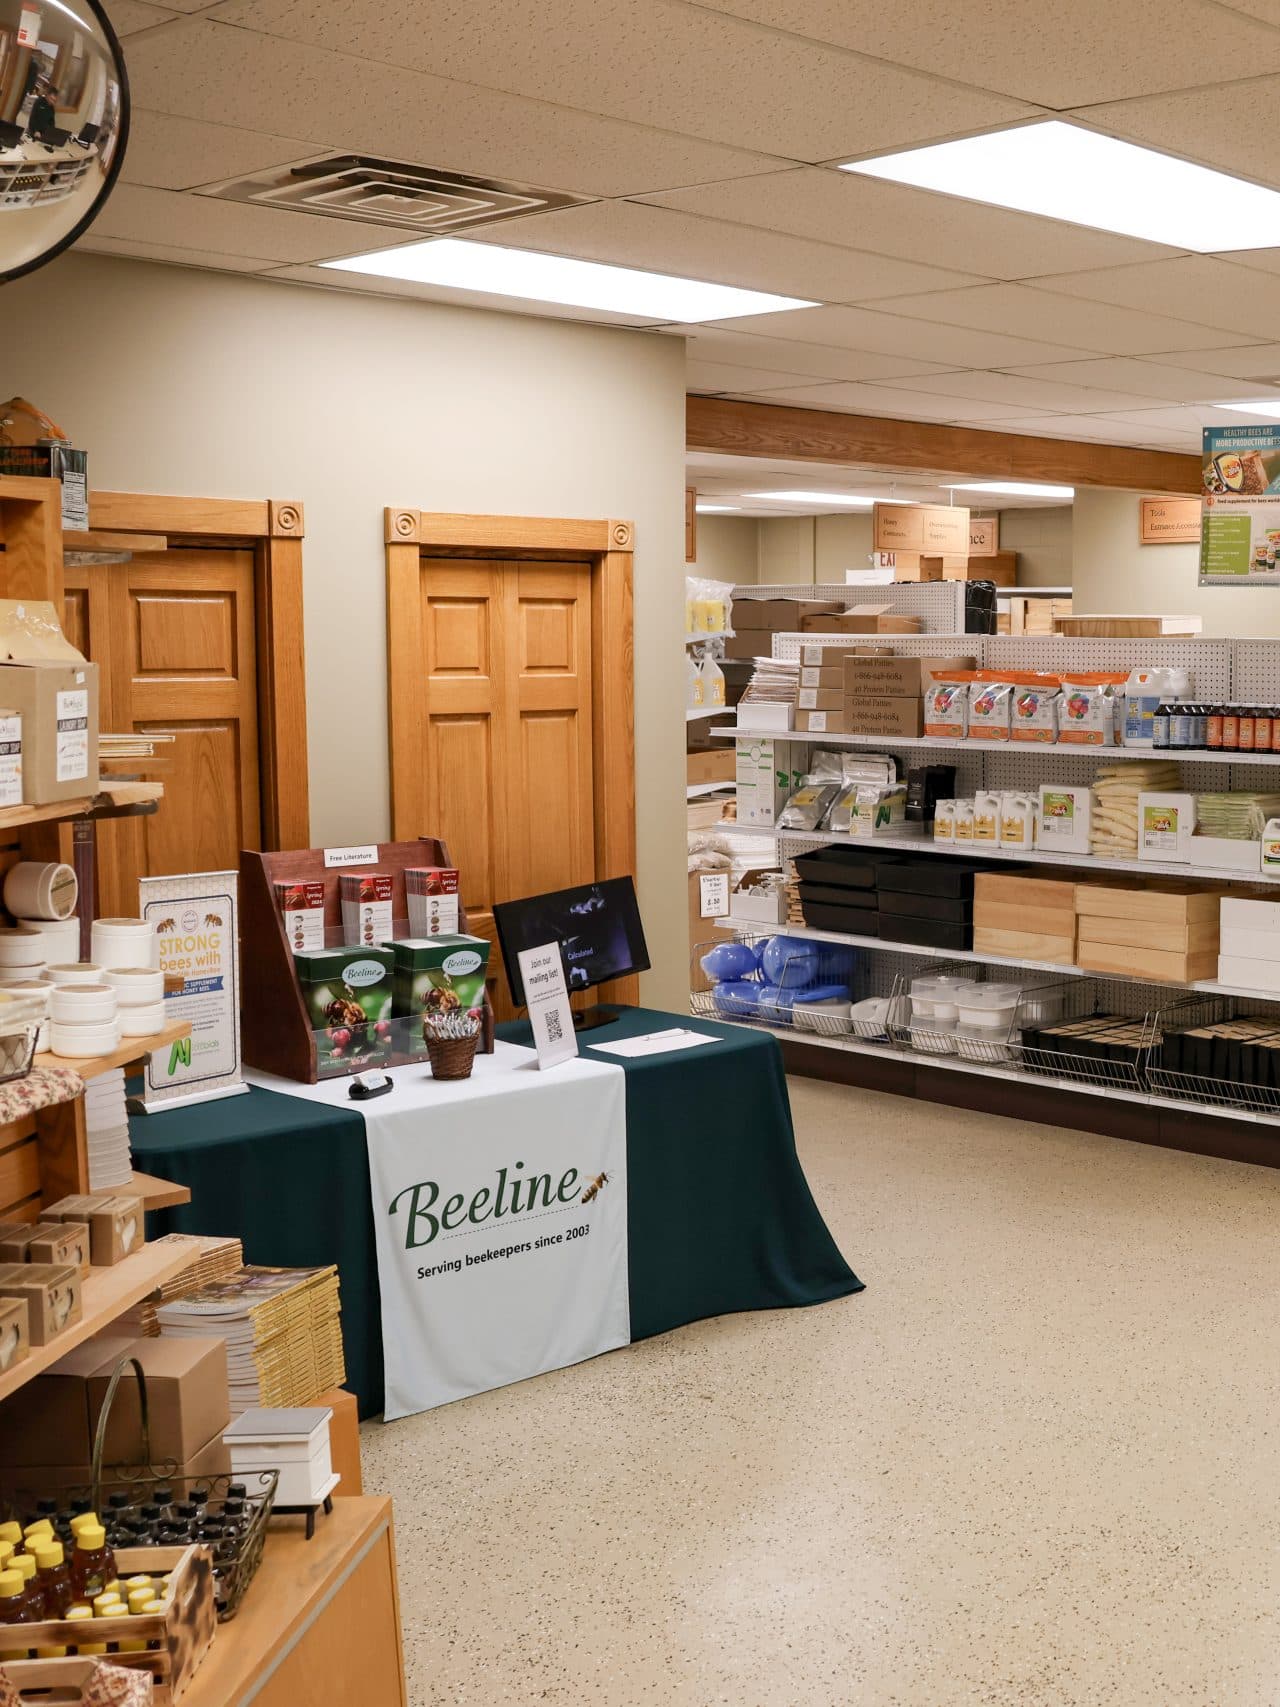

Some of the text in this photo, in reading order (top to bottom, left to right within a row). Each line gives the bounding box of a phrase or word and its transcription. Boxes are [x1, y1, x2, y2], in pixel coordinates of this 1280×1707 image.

[1223, 429, 1247, 437] HEALTHY
[1248, 428, 1262, 436] BEES
[1215, 437, 1280, 447] MORE PRODUCTIVE BEES
[1149, 509, 1166, 517] Tools
[883, 519, 898, 527] Honey
[880, 552, 896, 567] EXI
[853, 658, 894, 667] Global Patties
[852, 698, 892, 707] Global Patties
[860, 725, 882, 733] Protein
[329, 853, 372, 862] Free Literature
[441, 879, 457, 887] Spring
[375, 885, 391, 893] Spring
[306, 892, 322, 900] Spring
[159, 932, 221, 957] STRONG
[567, 947, 594, 961] Calculated
[159, 951, 221, 971] bees with
[445, 956, 474, 969] Beeline
[530, 957, 552, 969] Join our
[345, 966, 377, 979] Beeline
[529, 969, 559, 985] mailing list!
[189, 977, 218, 988] SUPPLEMENT
[182, 986, 198, 995] HONEY
[388, 1161, 582, 1250] Beeline
[417, 1224, 590, 1279] Serving beekeepers since 2003
